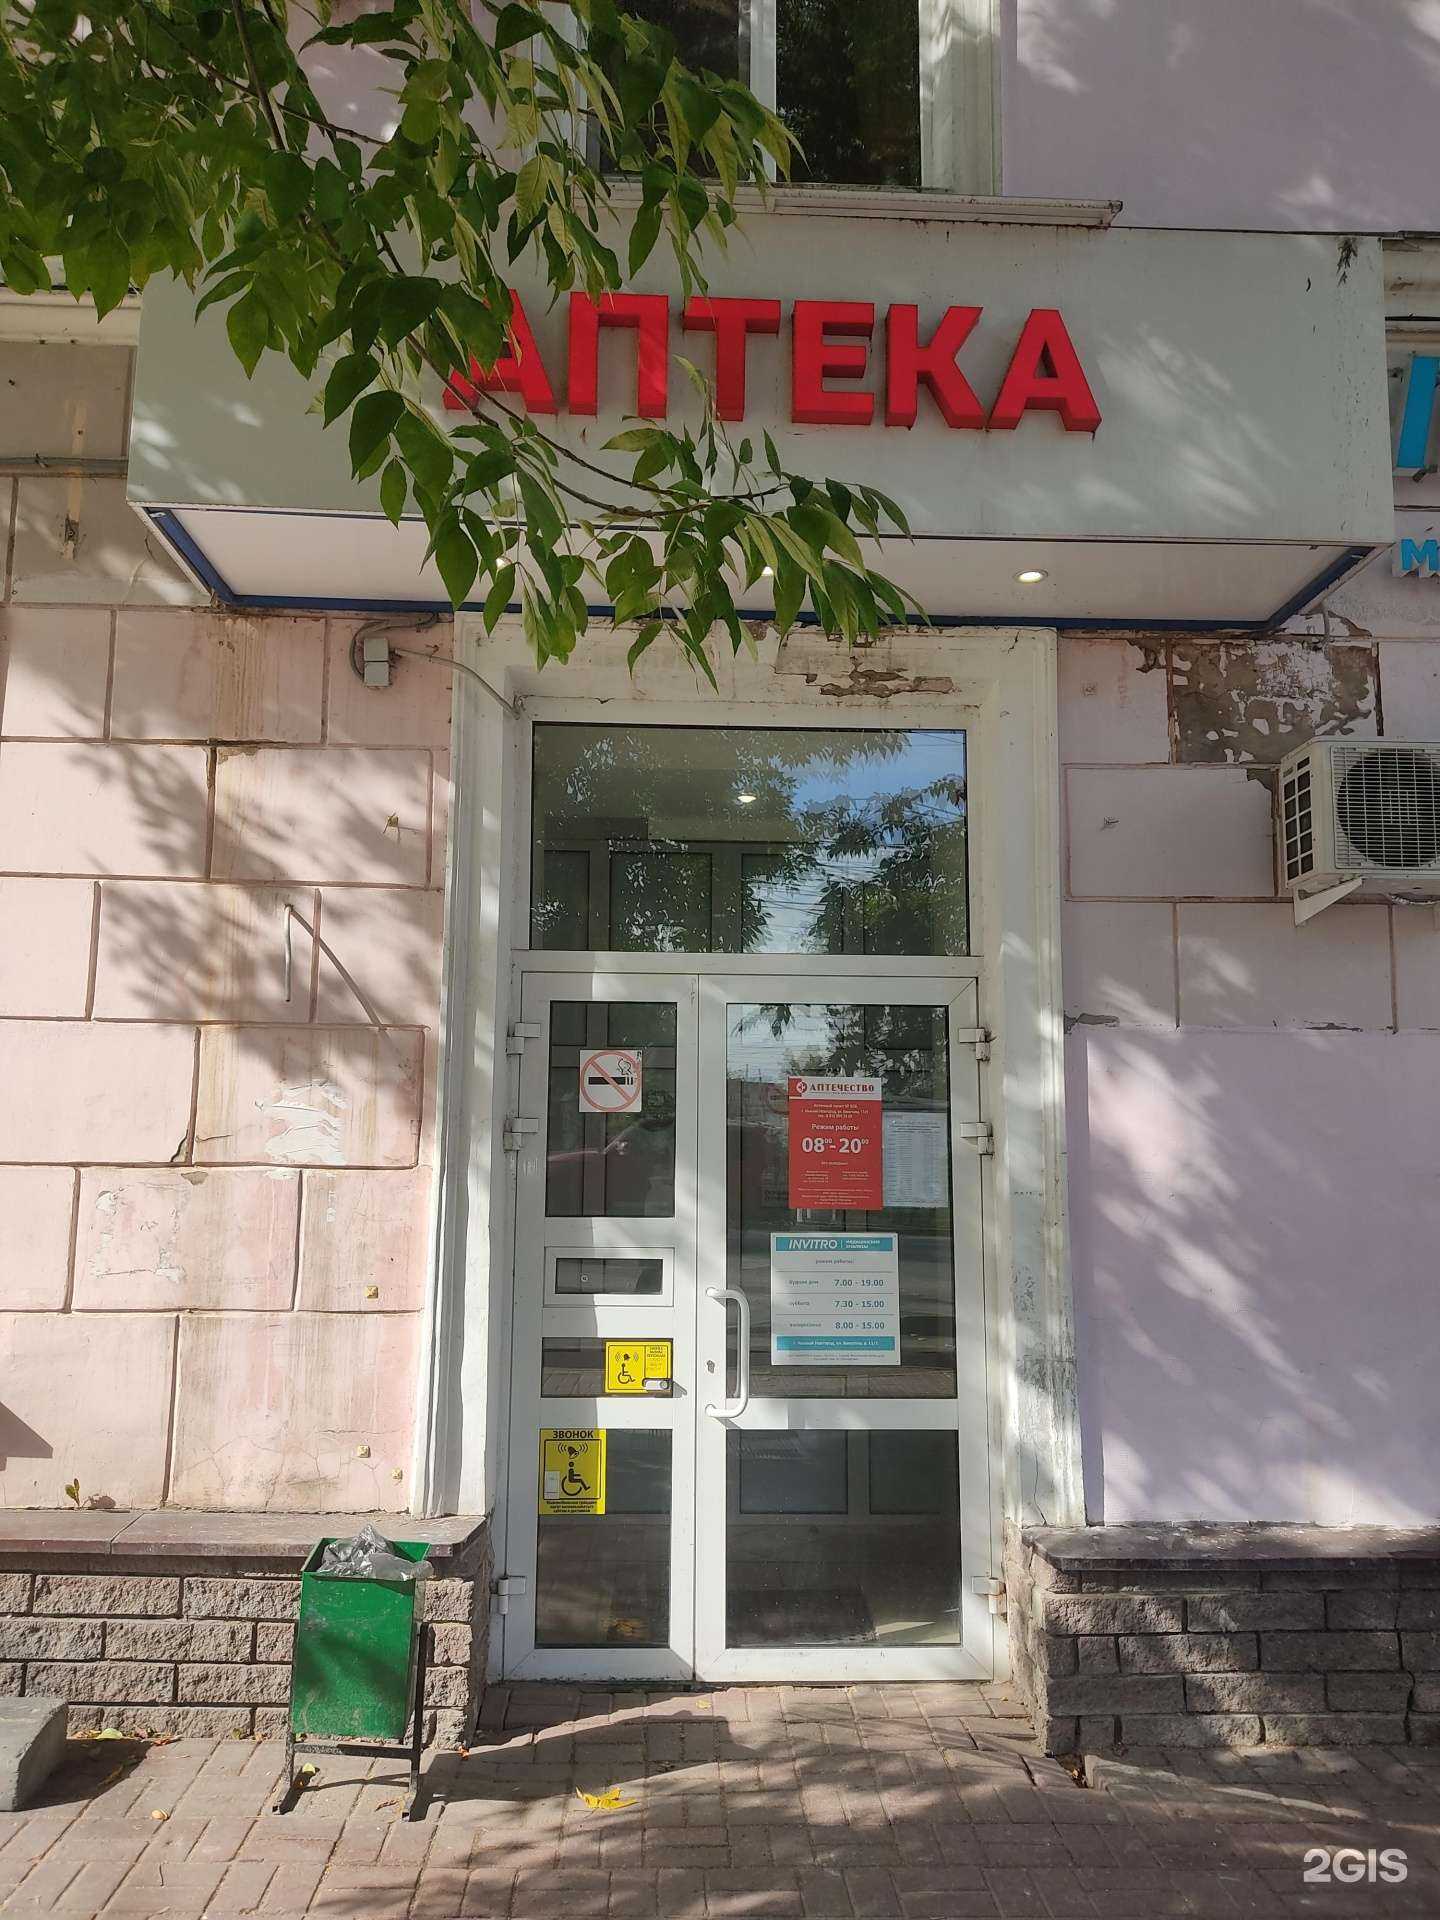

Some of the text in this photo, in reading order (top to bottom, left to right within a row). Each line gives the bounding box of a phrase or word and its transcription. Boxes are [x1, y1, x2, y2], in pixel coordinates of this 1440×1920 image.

[443, 289, 1102, 432] АПТЕКА
[809, 1083, 875, 1092] АПТЕЧЕСТВО
[788, 1239, 838, 1249] INVITRO
[834, 1279, 853, 1287] 7.00
[862, 1300, 885, 1308] 15.00
[834, 1321, 854, 1329] 8.00
[862, 1321, 885, 1329] 15.00
[552, 1430, 594, 1439] ЗВОНОК
